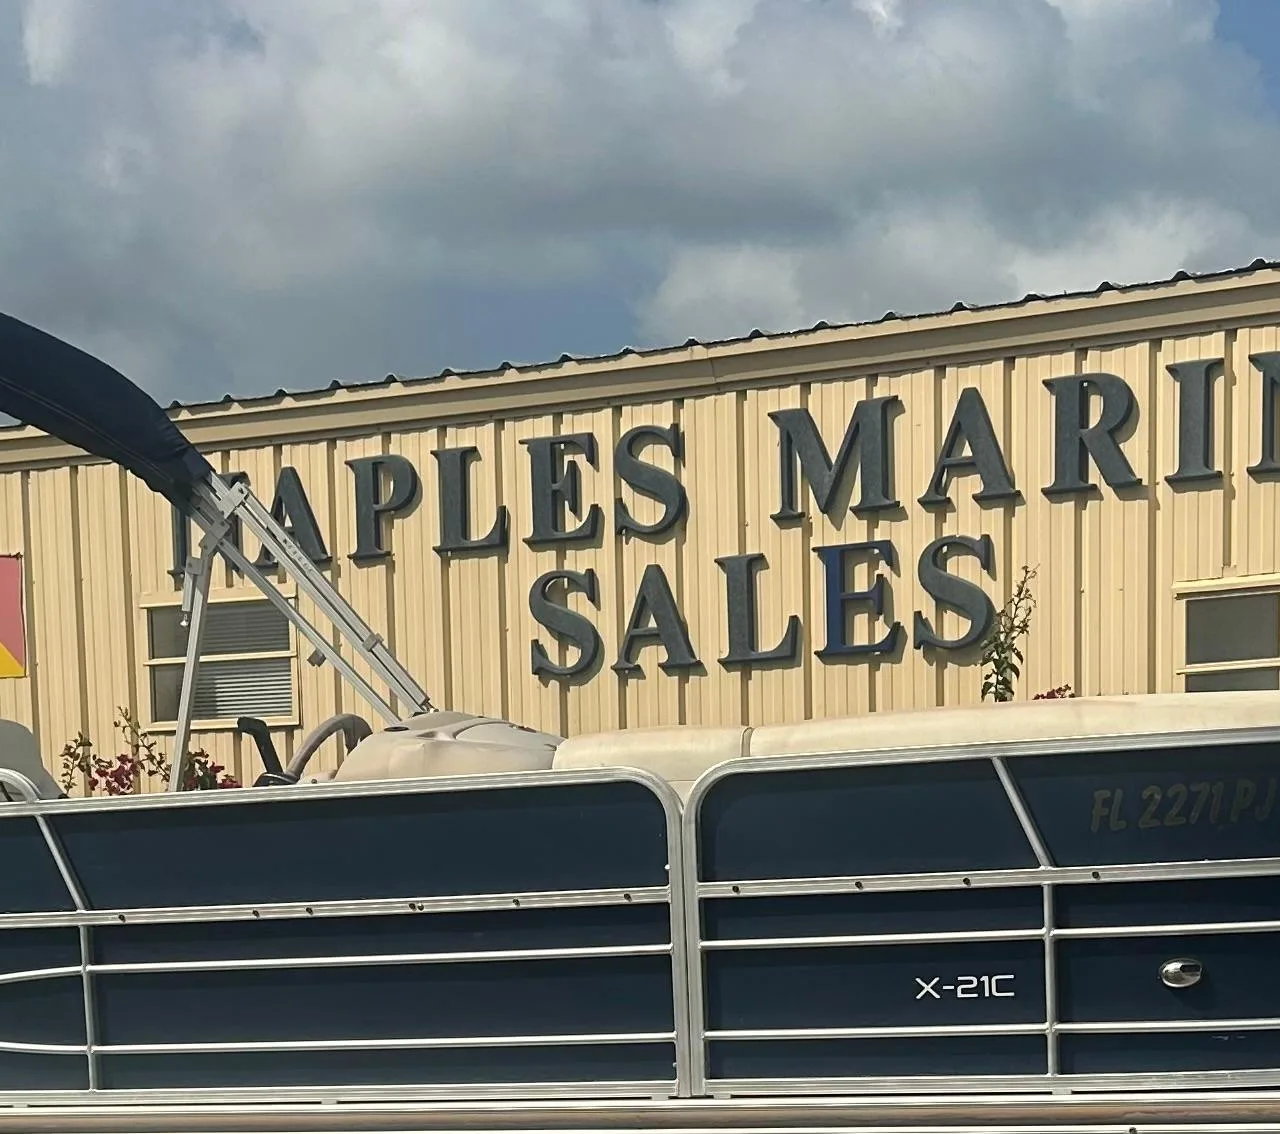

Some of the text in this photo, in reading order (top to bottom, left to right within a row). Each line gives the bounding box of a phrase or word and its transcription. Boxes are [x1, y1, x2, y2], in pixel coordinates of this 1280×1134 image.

[529, 534, 995, 679] SALES
[1090, 771, 1278, 834] FL 2271 PJ
[915, 974, 1015, 999] X-21C
